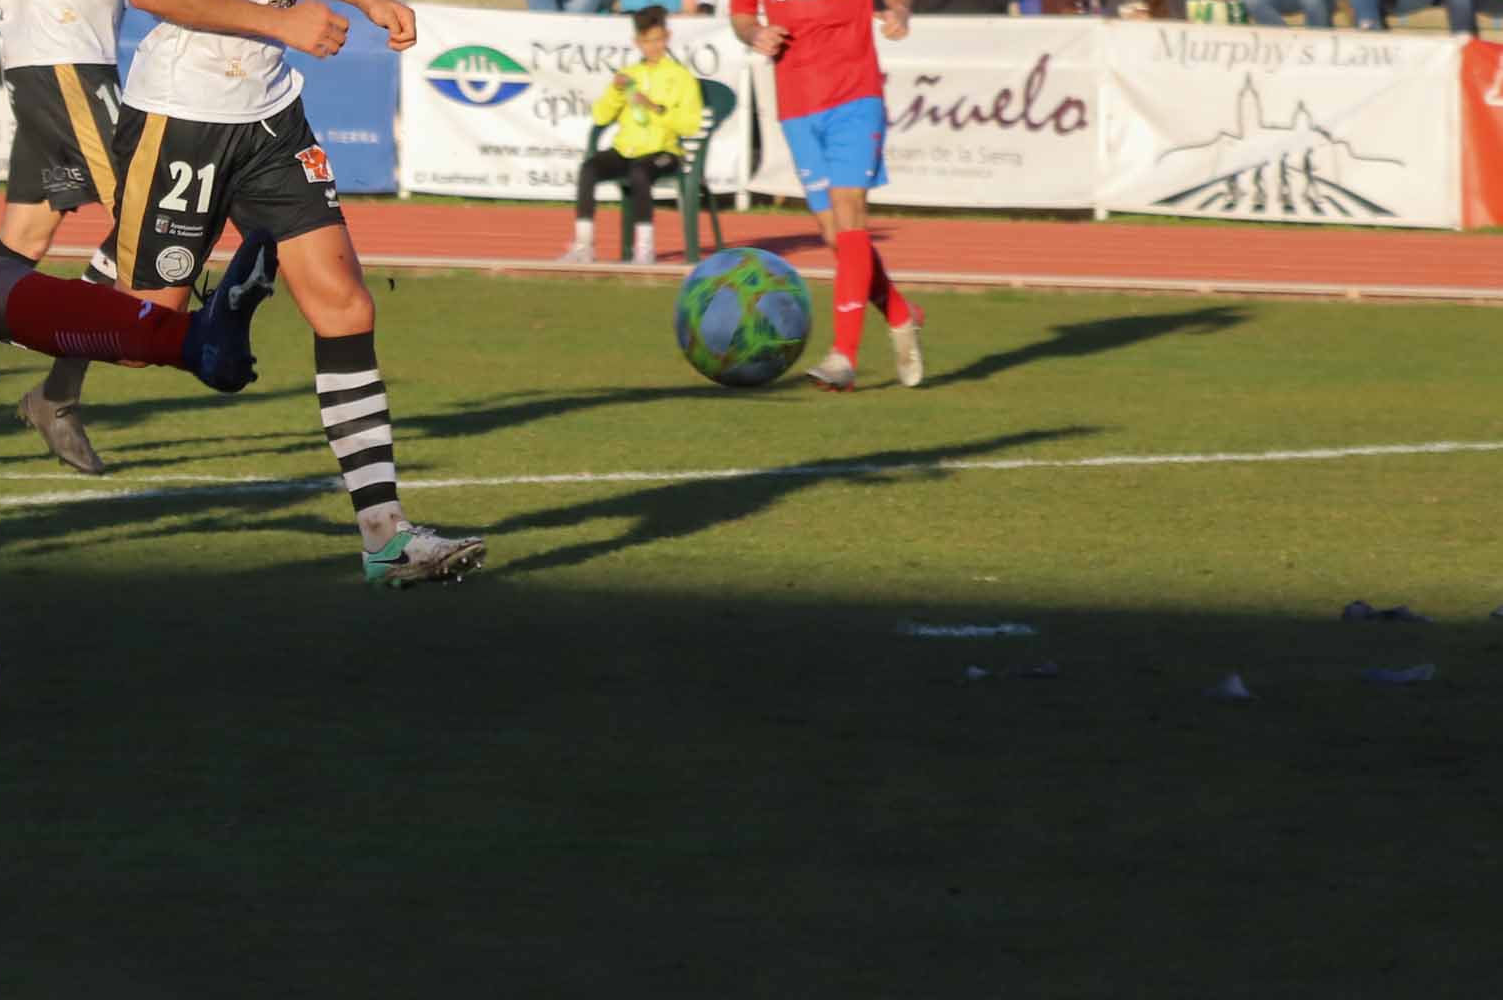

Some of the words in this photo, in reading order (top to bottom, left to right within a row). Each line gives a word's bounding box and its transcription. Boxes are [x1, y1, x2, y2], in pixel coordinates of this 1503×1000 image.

[1152, 29, 1317, 74] Murphy's
[1328, 34, 1402, 66] Law
[883, 53, 1089, 136] ñuelo
[159, 161, 216, 214] 21
